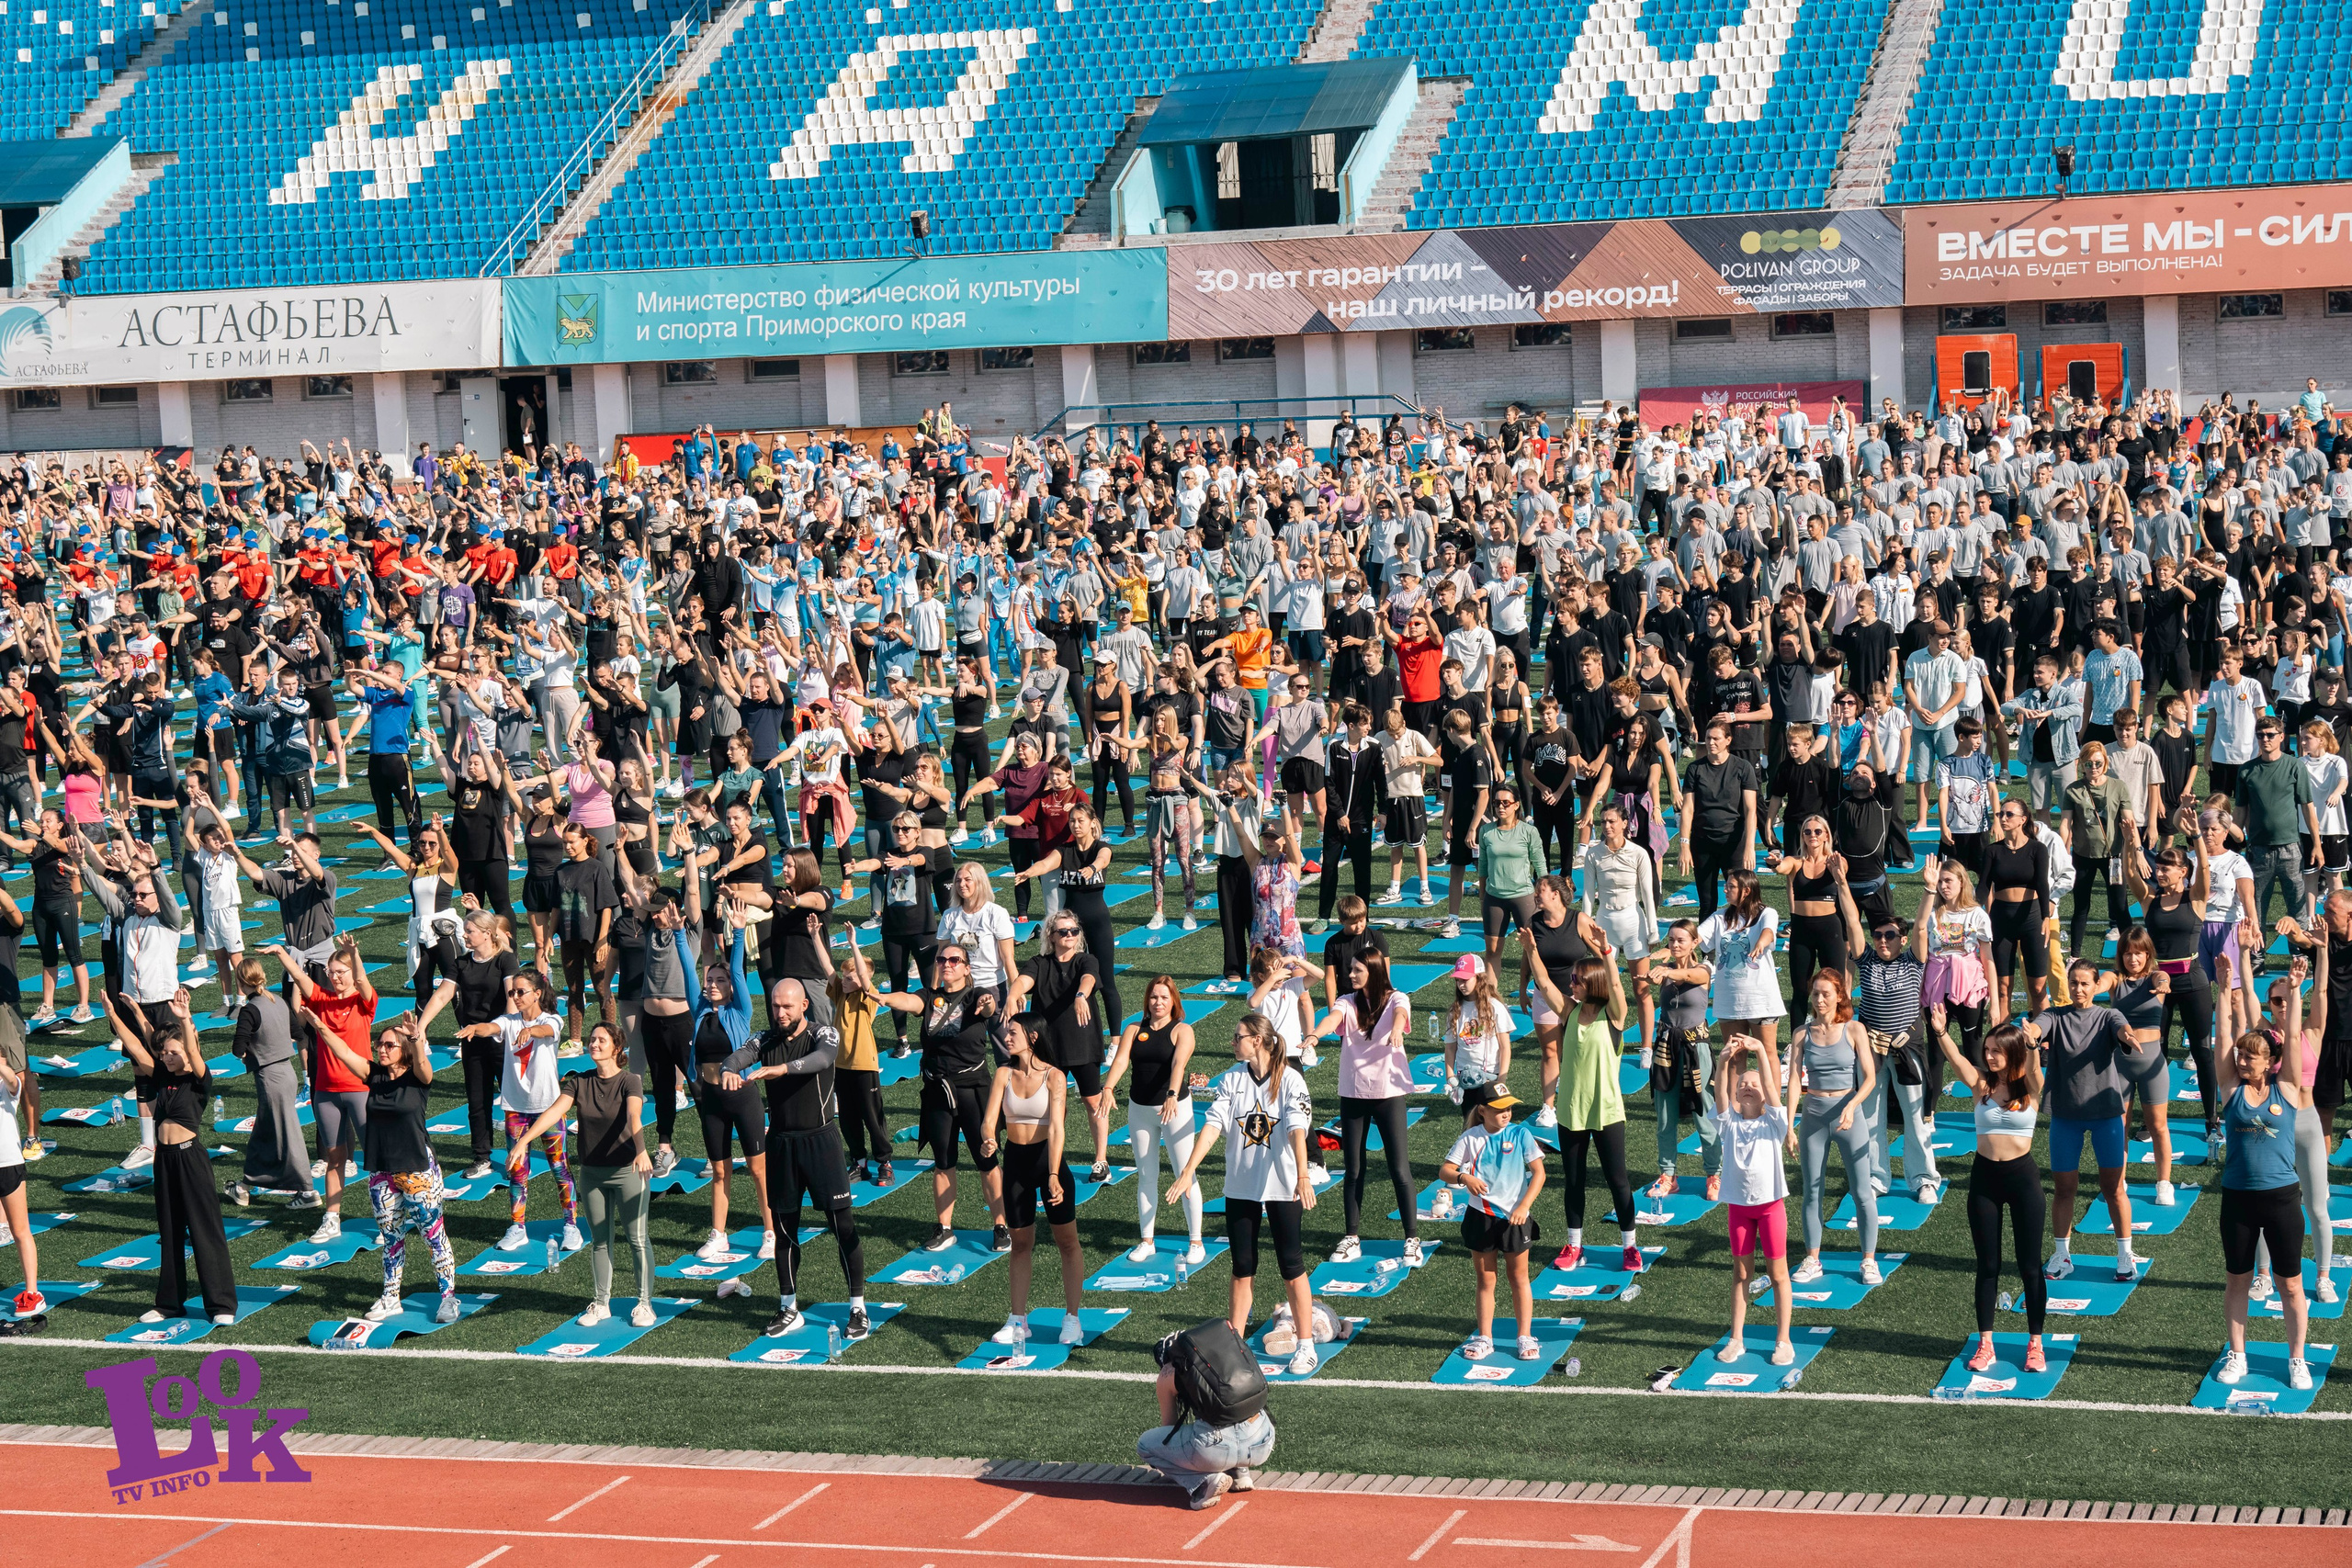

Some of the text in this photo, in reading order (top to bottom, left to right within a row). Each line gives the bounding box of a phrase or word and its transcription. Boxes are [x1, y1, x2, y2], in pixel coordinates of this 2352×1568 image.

[1937, 223, 2130, 263] ВМЕСТЕ
[2143, 219, 2225, 252] МЫ
[1194, 268, 1239, 292] 30
[1245, 270, 1302, 290] лет
[1308, 261, 1463, 288] гарантии
[1800, 257, 1860, 276] GROUP
[1939, 253, 2223, 281] ЗАДАЧА БУДЕТ ВЫПОЛНЕНА!
[636, 277, 1081, 313] Министерство физической культуры
[1327, 277, 1680, 320] наш личный рекорд!
[1715, 283, 1772, 295] ТЕРРАСЫ
[1779, 278, 1866, 292] ОГРАЖДЕНИЯ
[1733, 294, 1791, 306] ФАСАДЫ
[1797, 292, 1849, 303] ЗАБОРЫ
[118, 294, 402, 348] АСТАФЬЕВА
[636, 312, 967, 344] и спорта Приморского края
[14, 362, 89, 378] АСТАФЬЕВА
[187, 345, 331, 369] ТЕРМИНАЛ
[1736, 389, 1798, 400] РОССИЙСКИЙ
